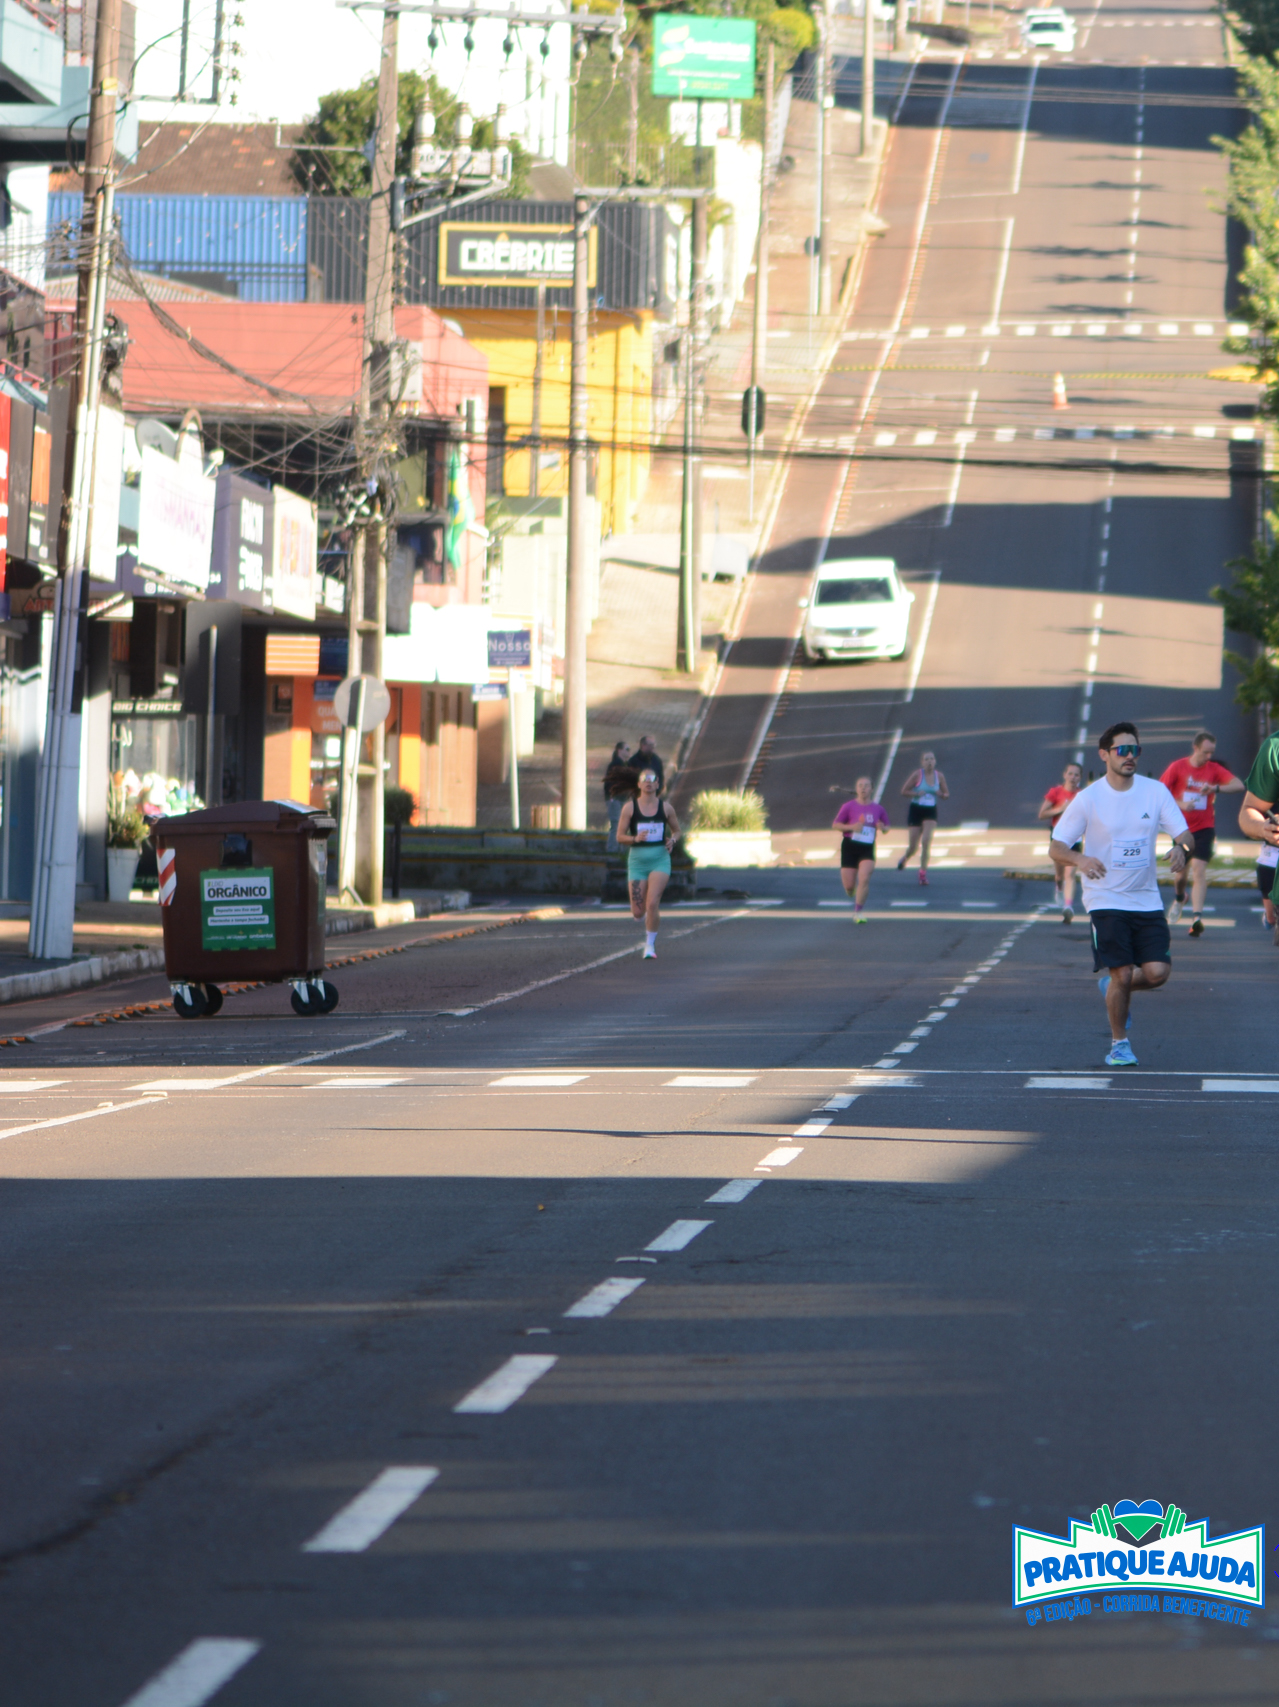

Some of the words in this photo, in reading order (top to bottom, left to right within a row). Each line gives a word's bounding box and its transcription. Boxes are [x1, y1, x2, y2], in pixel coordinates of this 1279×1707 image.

[488, 638, 531, 652] Nosso
[112, 702, 133, 713] BIG
[135, 702, 182, 713] CHOICE
[1123, 848, 1141, 857] 229
[207, 884, 267, 898] ORGÂNICO
